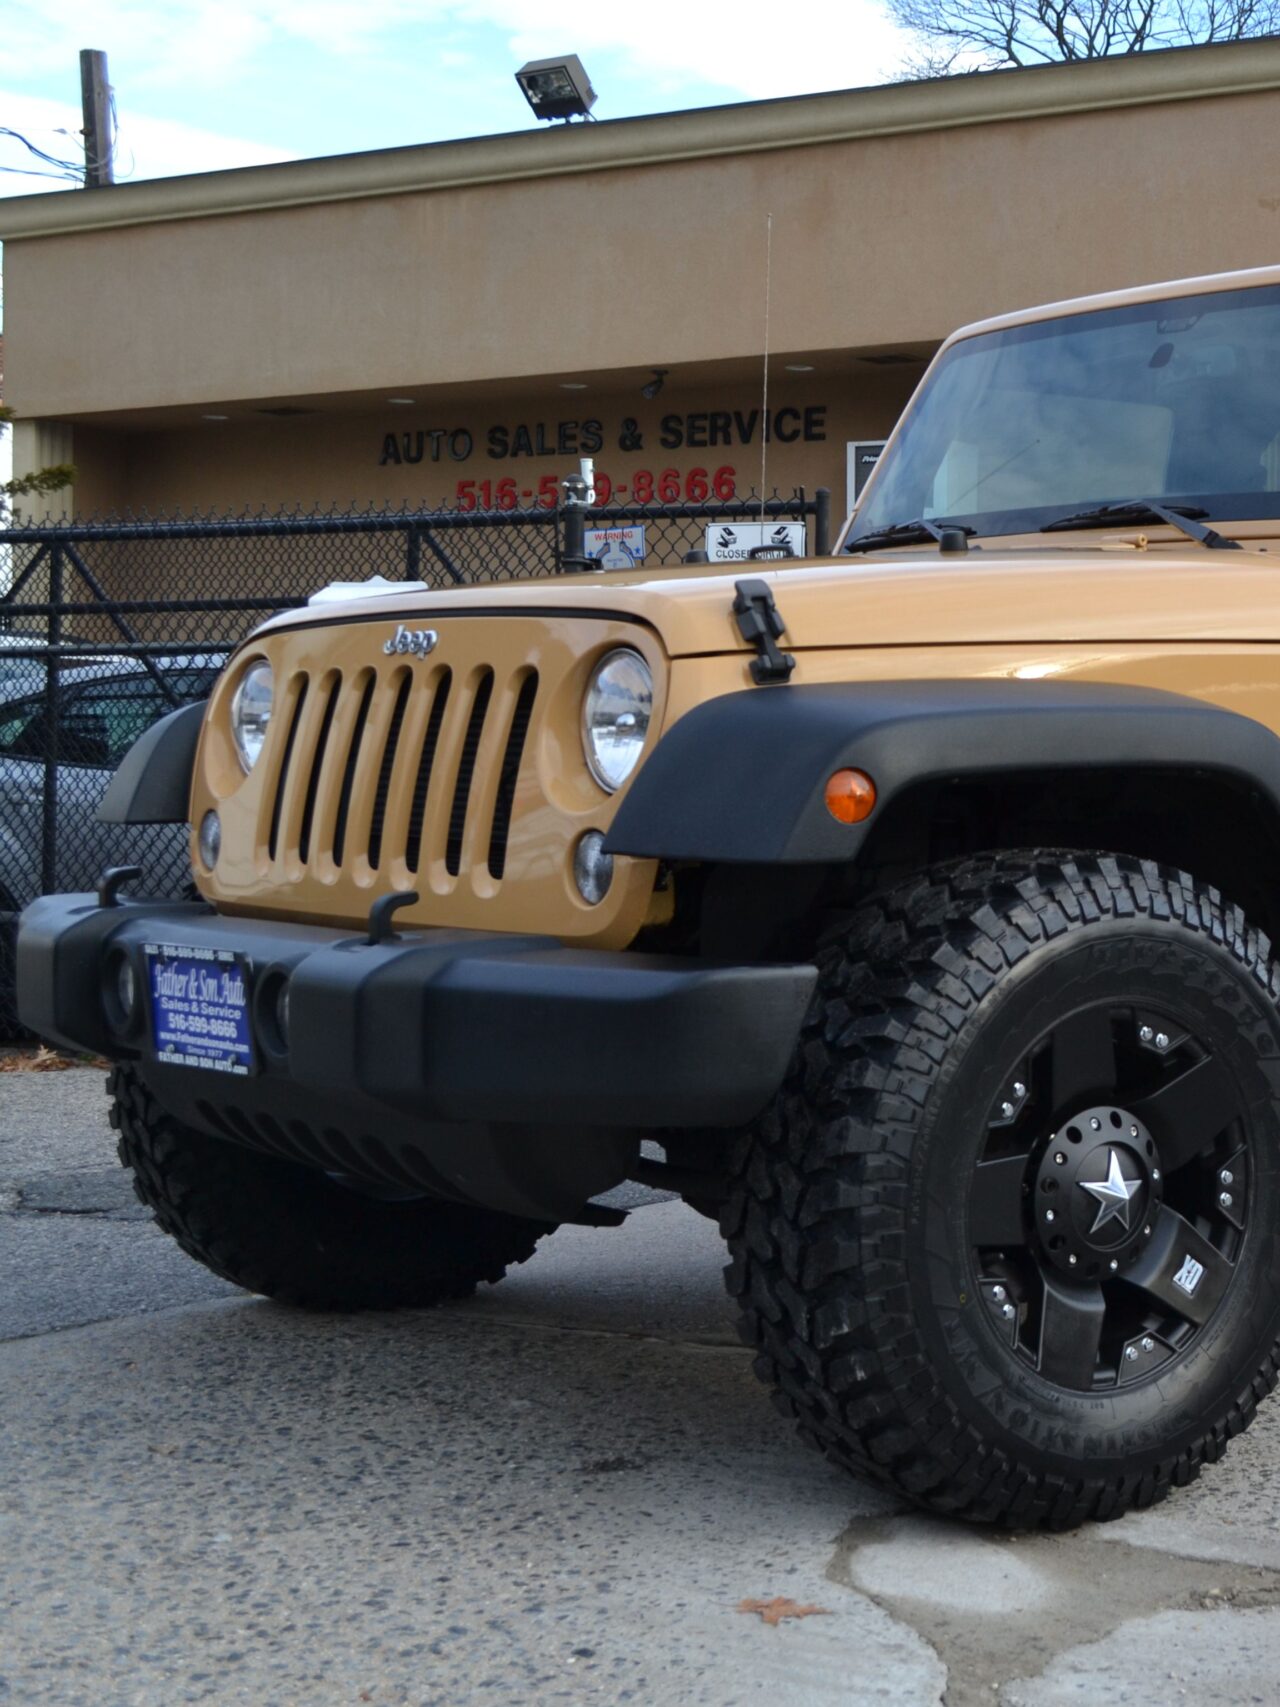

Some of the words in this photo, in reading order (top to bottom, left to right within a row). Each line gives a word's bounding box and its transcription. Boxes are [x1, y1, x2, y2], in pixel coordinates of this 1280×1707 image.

[379, 428, 473, 466] AUTO
[487, 419, 604, 459] SALES
[618, 417, 643, 451] &
[660, 406, 827, 449] SERVICE
[456, 465, 736, 512] 516-59-8666
[593, 530, 633, 541] WARNING
[383, 624, 438, 661] Jeep
[161, 997, 190, 1012] Sales
[191, 1001, 199, 1012] &
[200, 1002, 242, 1019] Service
[168, 1013, 238, 1039] 516-599-8666
